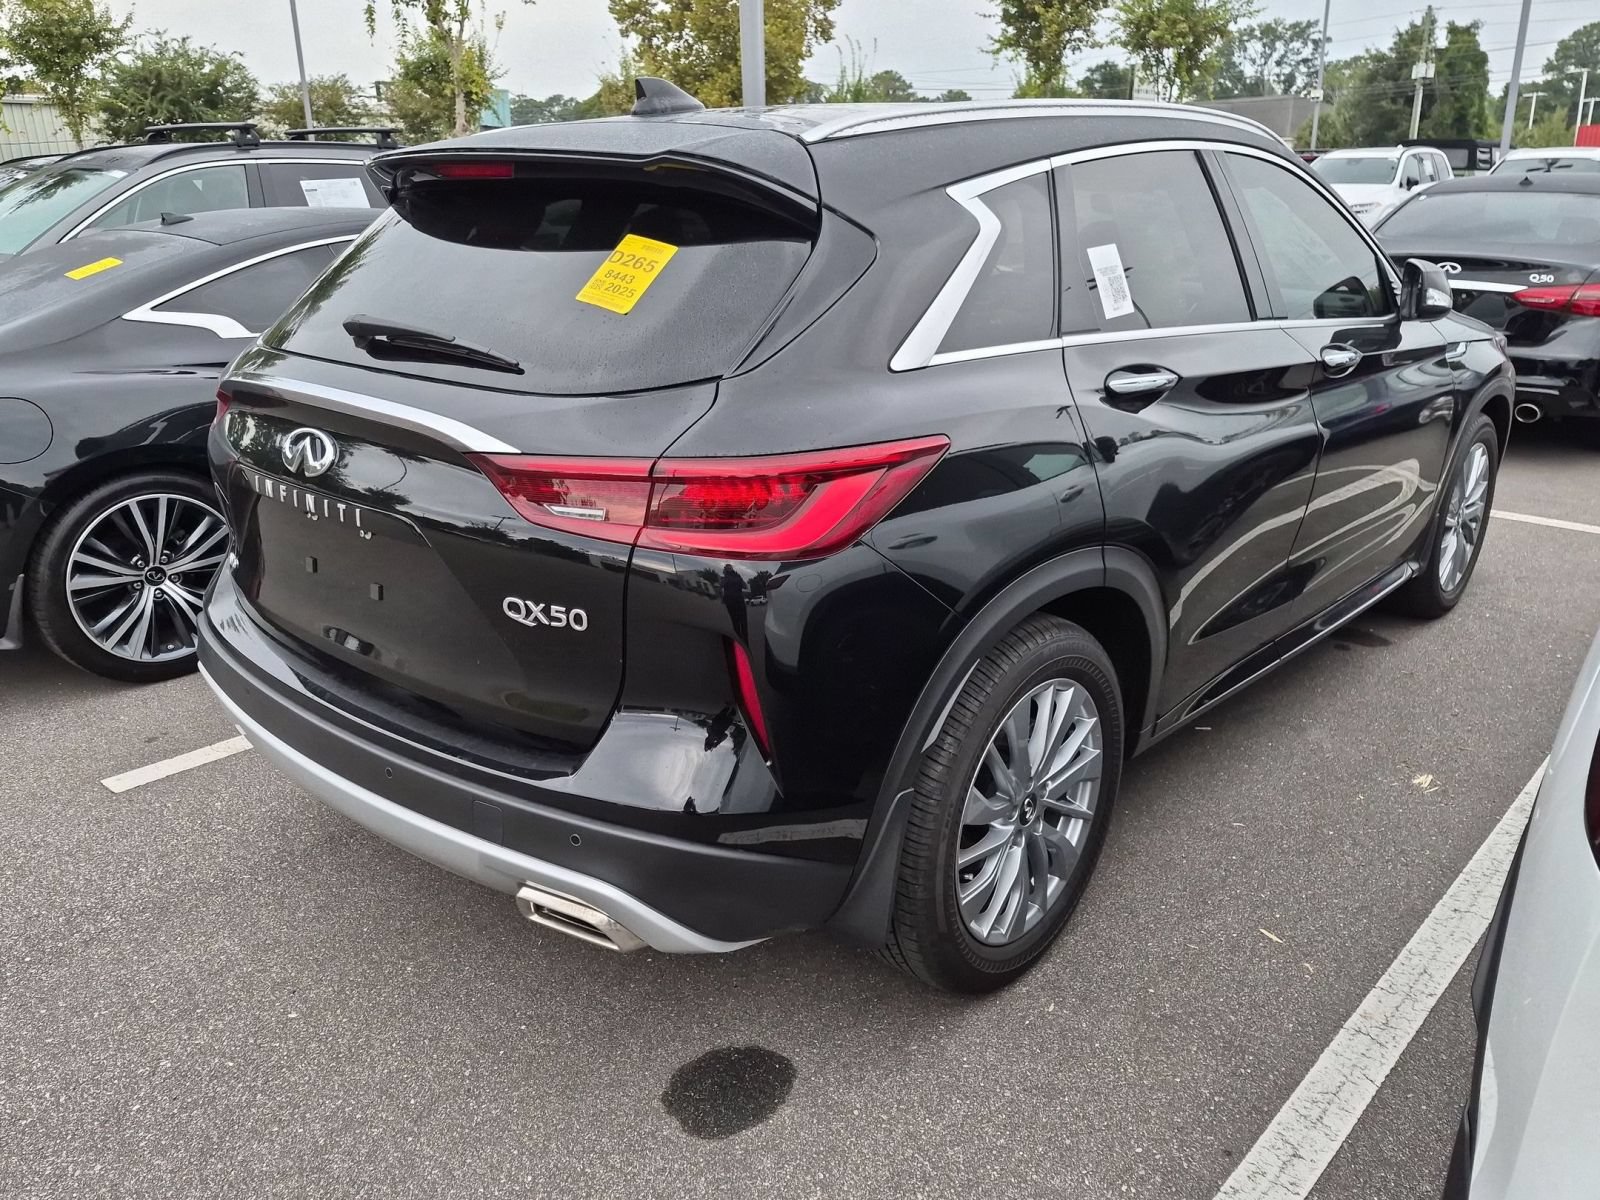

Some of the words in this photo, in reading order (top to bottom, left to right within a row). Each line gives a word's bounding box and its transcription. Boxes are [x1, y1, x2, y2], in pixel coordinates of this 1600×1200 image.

[608, 250, 659, 273] D265
[604, 269, 636, 285] 8443
[1529, 273, 1555, 284] Q50
[603, 282, 638, 299] 2025
[254, 475, 361, 528] INFINITI
[502, 596, 588, 632] QX50
